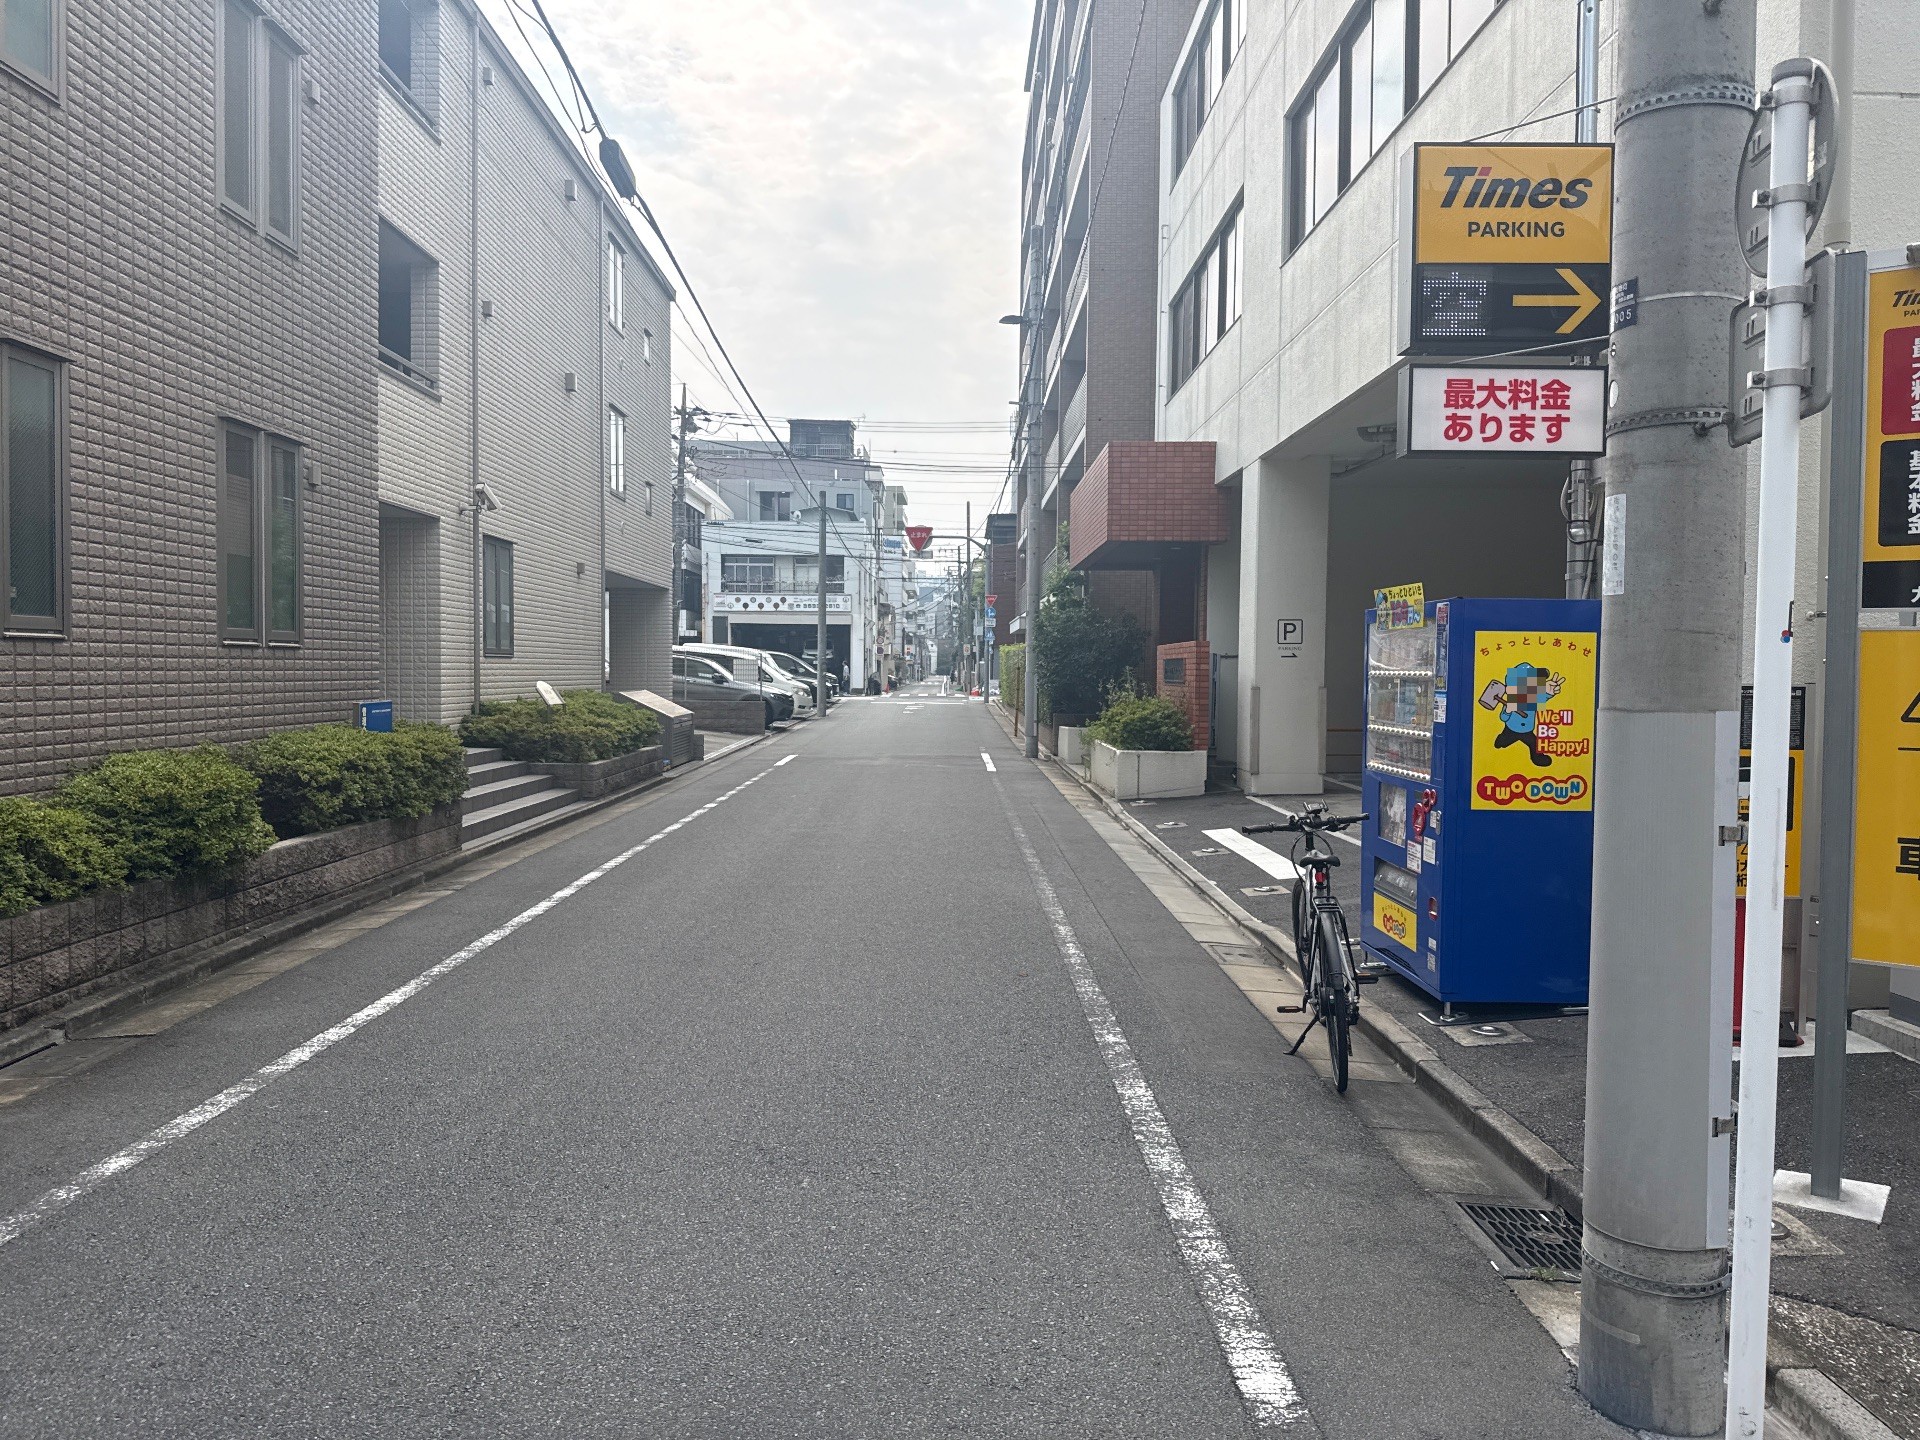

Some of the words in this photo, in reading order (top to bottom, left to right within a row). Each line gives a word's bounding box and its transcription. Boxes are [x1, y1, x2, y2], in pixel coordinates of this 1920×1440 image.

[1440, 167, 1593, 209] Times
[1467, 221, 1565, 238] PARKING
[1422, 272, 1487, 336] 空
[1443, 378, 1571, 411] 最大料金
[1443, 412, 1571, 443] あります
[1283, 622, 1297, 641] P
[1480, 636, 1591, 658] ちょっとしあわせ
[1537, 710, 1572, 724] We'll
[1537, 725, 1557, 738] Be
[1537, 739, 1589, 756] Happy!
